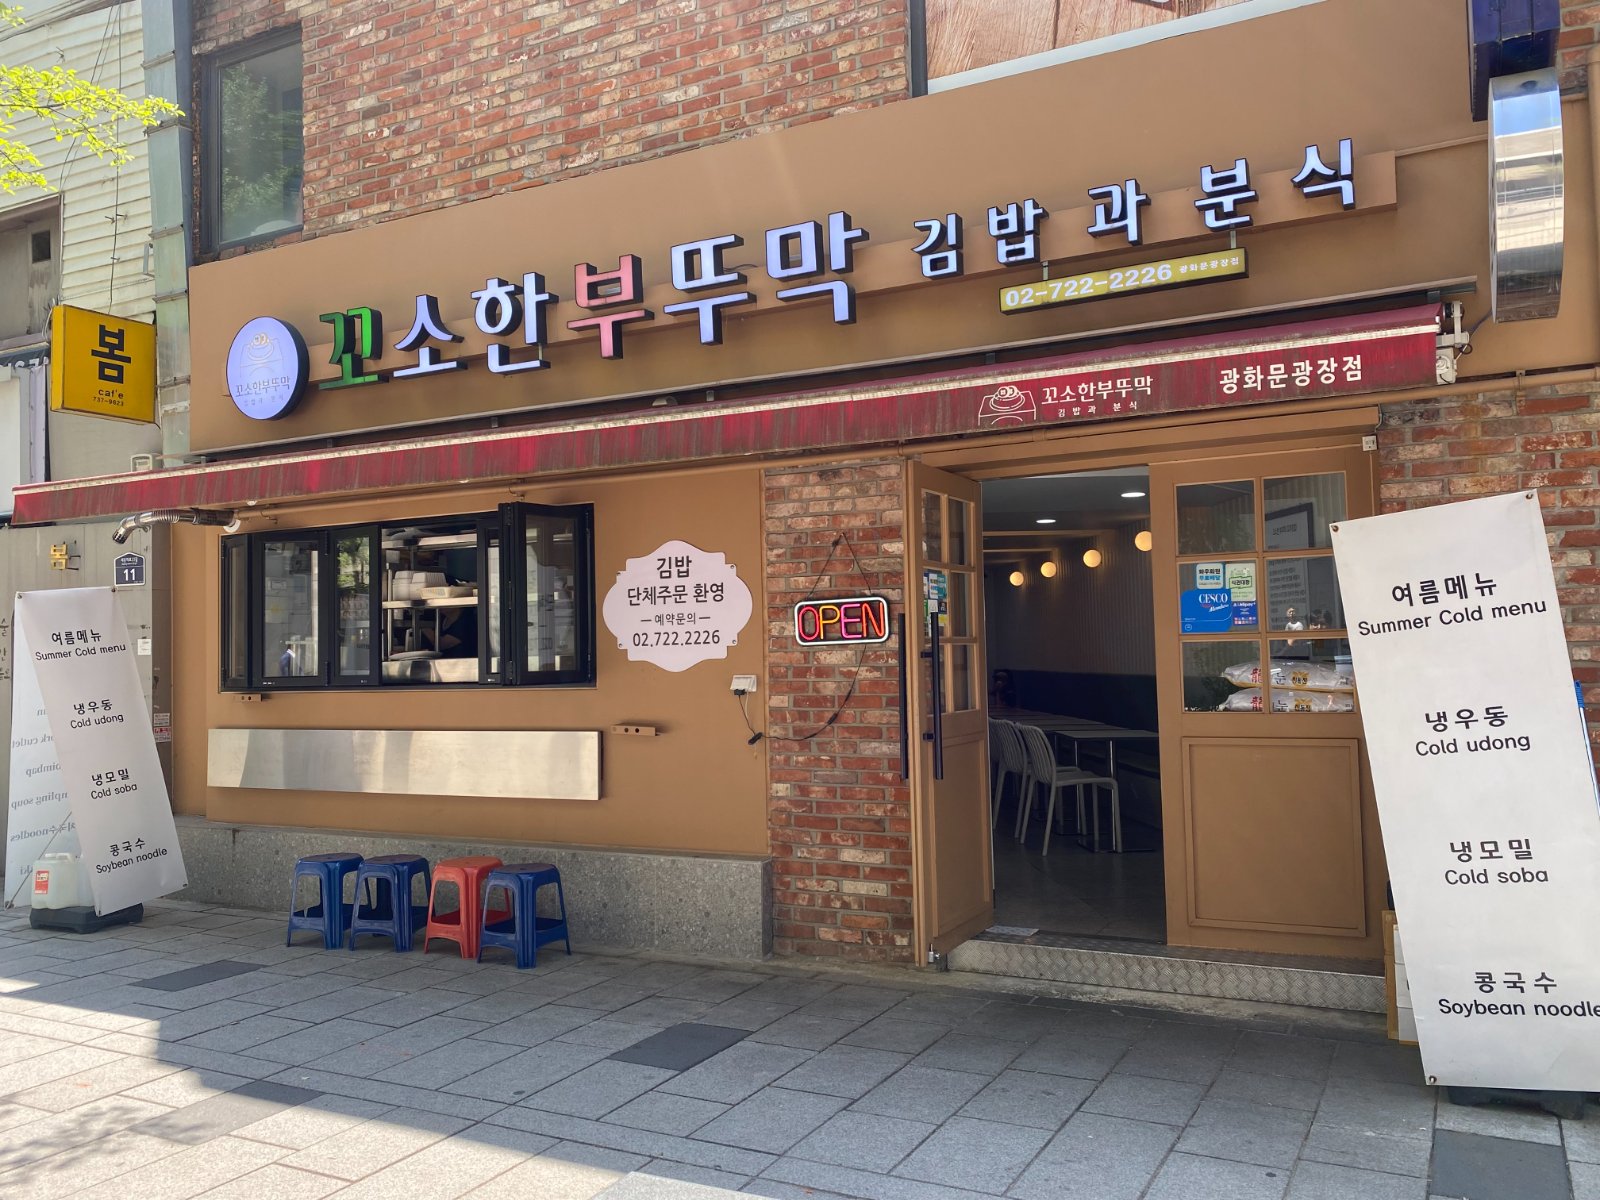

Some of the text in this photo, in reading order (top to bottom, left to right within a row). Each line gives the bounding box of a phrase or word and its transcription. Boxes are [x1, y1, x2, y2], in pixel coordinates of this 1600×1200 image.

[912, 137, 1355, 280] 김밥과 분식
[1005, 264, 1172, 306] 02-722-2226
[318, 210, 868, 390] 꼬소한부뚜막
[91, 324, 131, 384] 봄
[1219, 354, 1362, 394] 광화문광장점
[1041, 375, 1153, 404] 꼬소한부뚜막
[1058, 401, 1137, 418] 김밥과 분식
[123, 568, 136, 581] 11
[656, 555, 692, 579] 김밥
[627, 582, 725, 606] 단체주문 환영
[1198, 592, 1228, 604] CESCO
[1392, 572, 1497, 607] 여름메뉴
[654, 612, 696, 626] 예약문의
[798, 601, 885, 641] OPEN
[1358, 600, 1547, 636] Summer Cold menu
[51, 629, 102, 646] 여름메뉴
[633, 630, 721, 648] 02.722.2226
[35, 651, 72, 661] Summer
[75, 645, 97, 657] Cold
[100, 643, 126, 654] menu
[73, 699, 113, 715] 냉우동
[70, 714, 124, 729] Cold udong
[1425, 706, 1508, 732] 냉우동
[1415, 735, 1531, 756] Cold udong
[91, 768, 130, 786] 냉모밀
[91, 783, 138, 800] Cold soba
[110, 838, 146, 857] 콩국수
[1450, 838, 1533, 862] 냉모밀
[96, 848, 168, 874] Soybean noodle
[1445, 867, 1549, 885] Cold soba
[1474, 971, 1557, 994] 콩국수
[1438, 998, 1600, 1018] Soybean noodle
